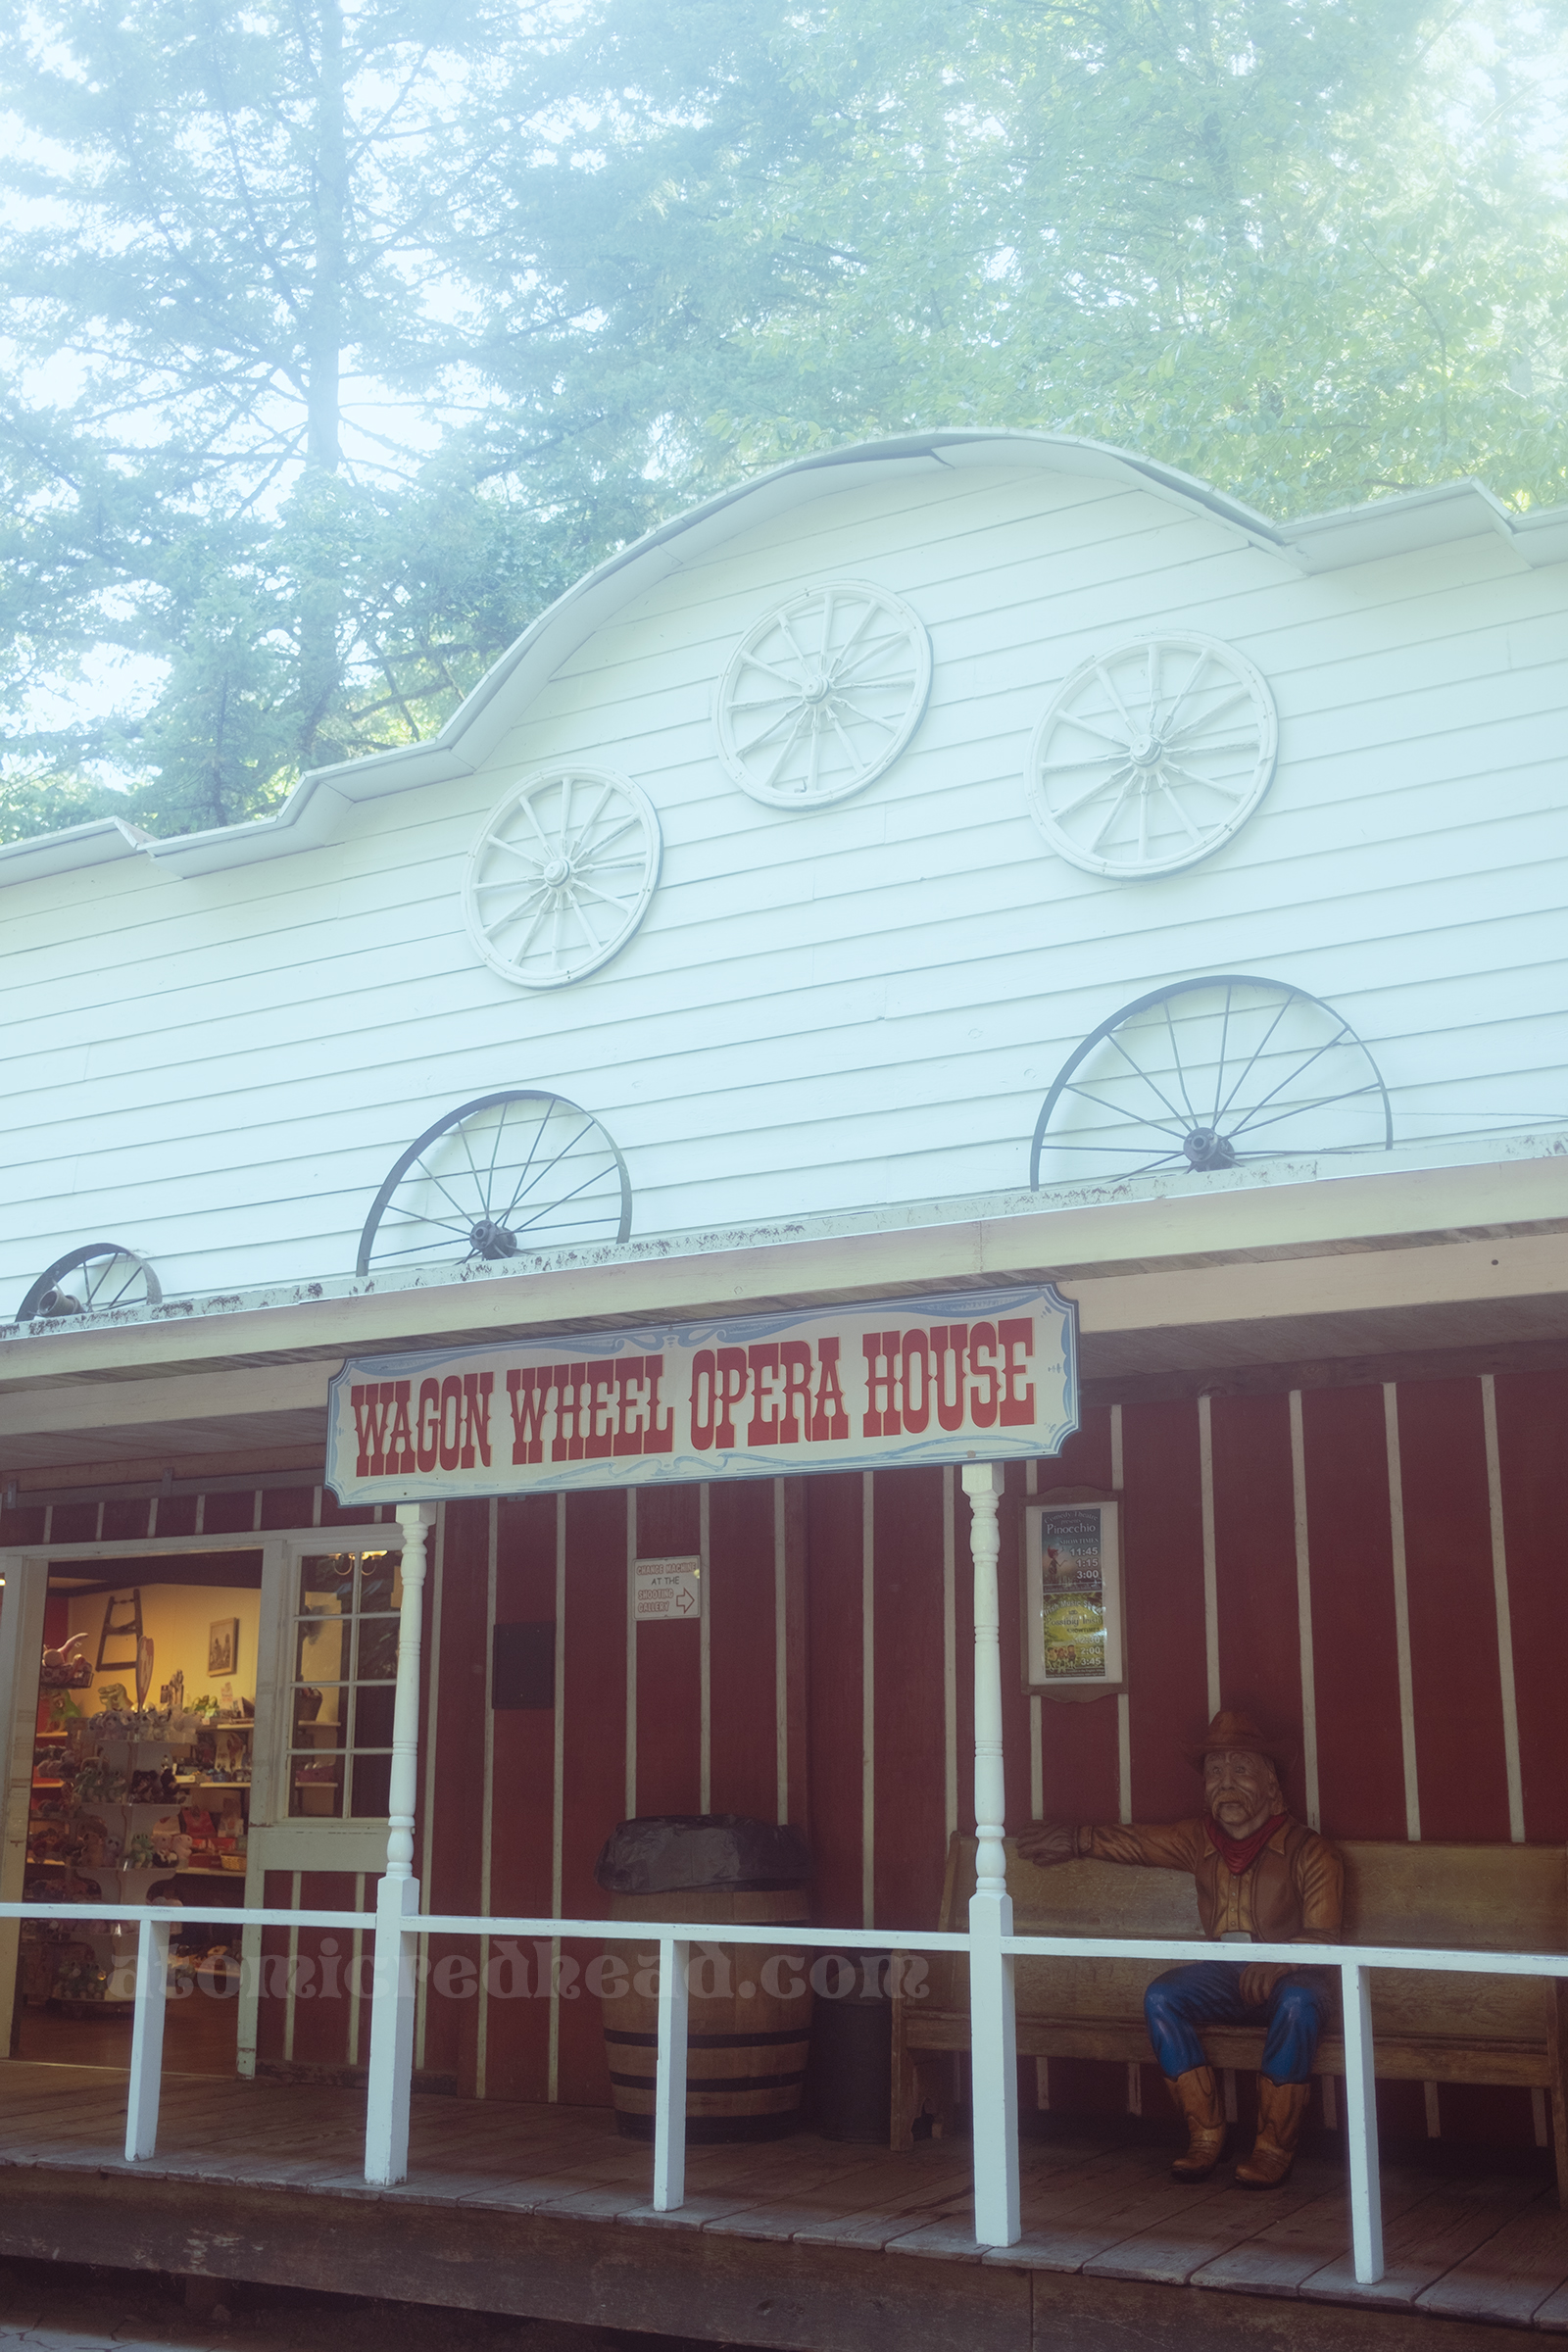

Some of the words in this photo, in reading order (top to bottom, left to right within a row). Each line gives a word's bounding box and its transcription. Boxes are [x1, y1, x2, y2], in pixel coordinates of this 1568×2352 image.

[351, 1372, 494, 1478] WAGON
[506, 1354, 674, 1466] WHEEL
[688, 1337, 851, 1451] OPERA
[861, 1317, 1036, 1439] HOUSE
[1044, 1512, 1071, 1523] Comedy
[1047, 1523, 1096, 1534] Pinocchio
[1070, 1546, 1098, 1556] 11:45
[1076, 1558, 1099, 1567] 1:15
[636, 1564, 663, 1575] CHANGE
[666, 1562, 696, 1573] MACHINE
[1076, 1570, 1099, 1579] 3:00
[664, 1576, 679, 1585] THE
[638, 1589, 673, 1600] SHOOTING
[638, 1601, 669, 1613] GALLERY
[1081, 1657, 1102, 1666] 3:45
